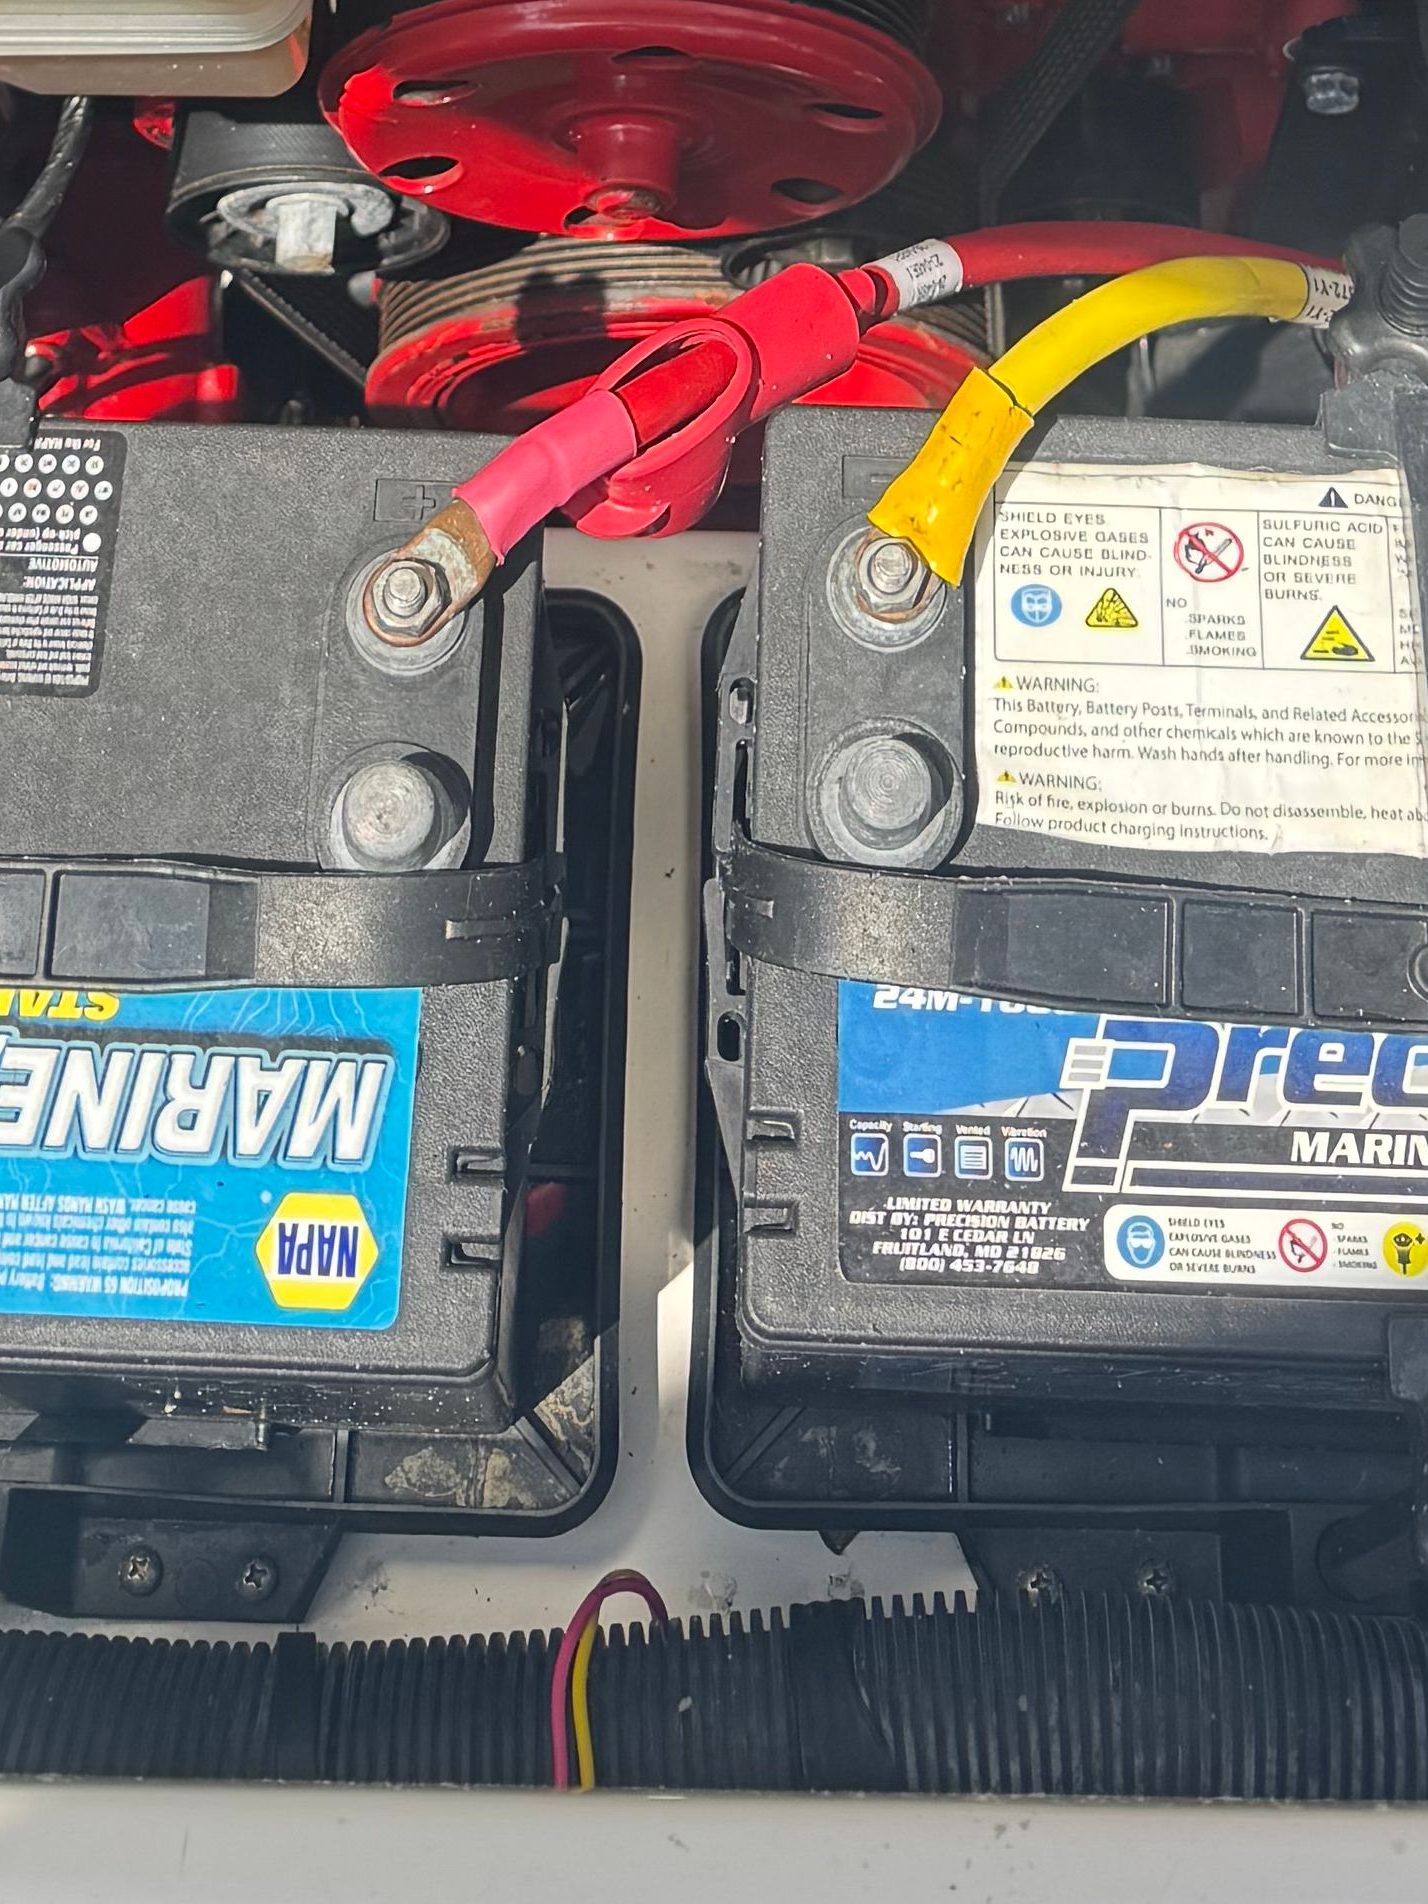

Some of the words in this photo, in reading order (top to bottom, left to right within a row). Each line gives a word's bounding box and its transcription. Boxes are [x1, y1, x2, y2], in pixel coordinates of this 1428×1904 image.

[1347, 521, 1383, 535] ACID
[1263, 536, 1296, 550] CAN
[999, 545, 1033, 559] CAN
[1038, 546, 1093, 560] CAUSE
[1050, 564, 1072, 577] OR
[1264, 571, 1287, 584] OR
[1166, 596, 1188, 609] NO
[956, 1198, 1051, 1215] WARRANTY
[924, 1213, 1010, 1229] PRECISION
[1016, 1216, 1090, 1232] BATTERY
[900, 1228, 932, 1241] 101
[953, 1230, 1008, 1243] CEDAR
[276, 1221, 359, 1279] NAPA
